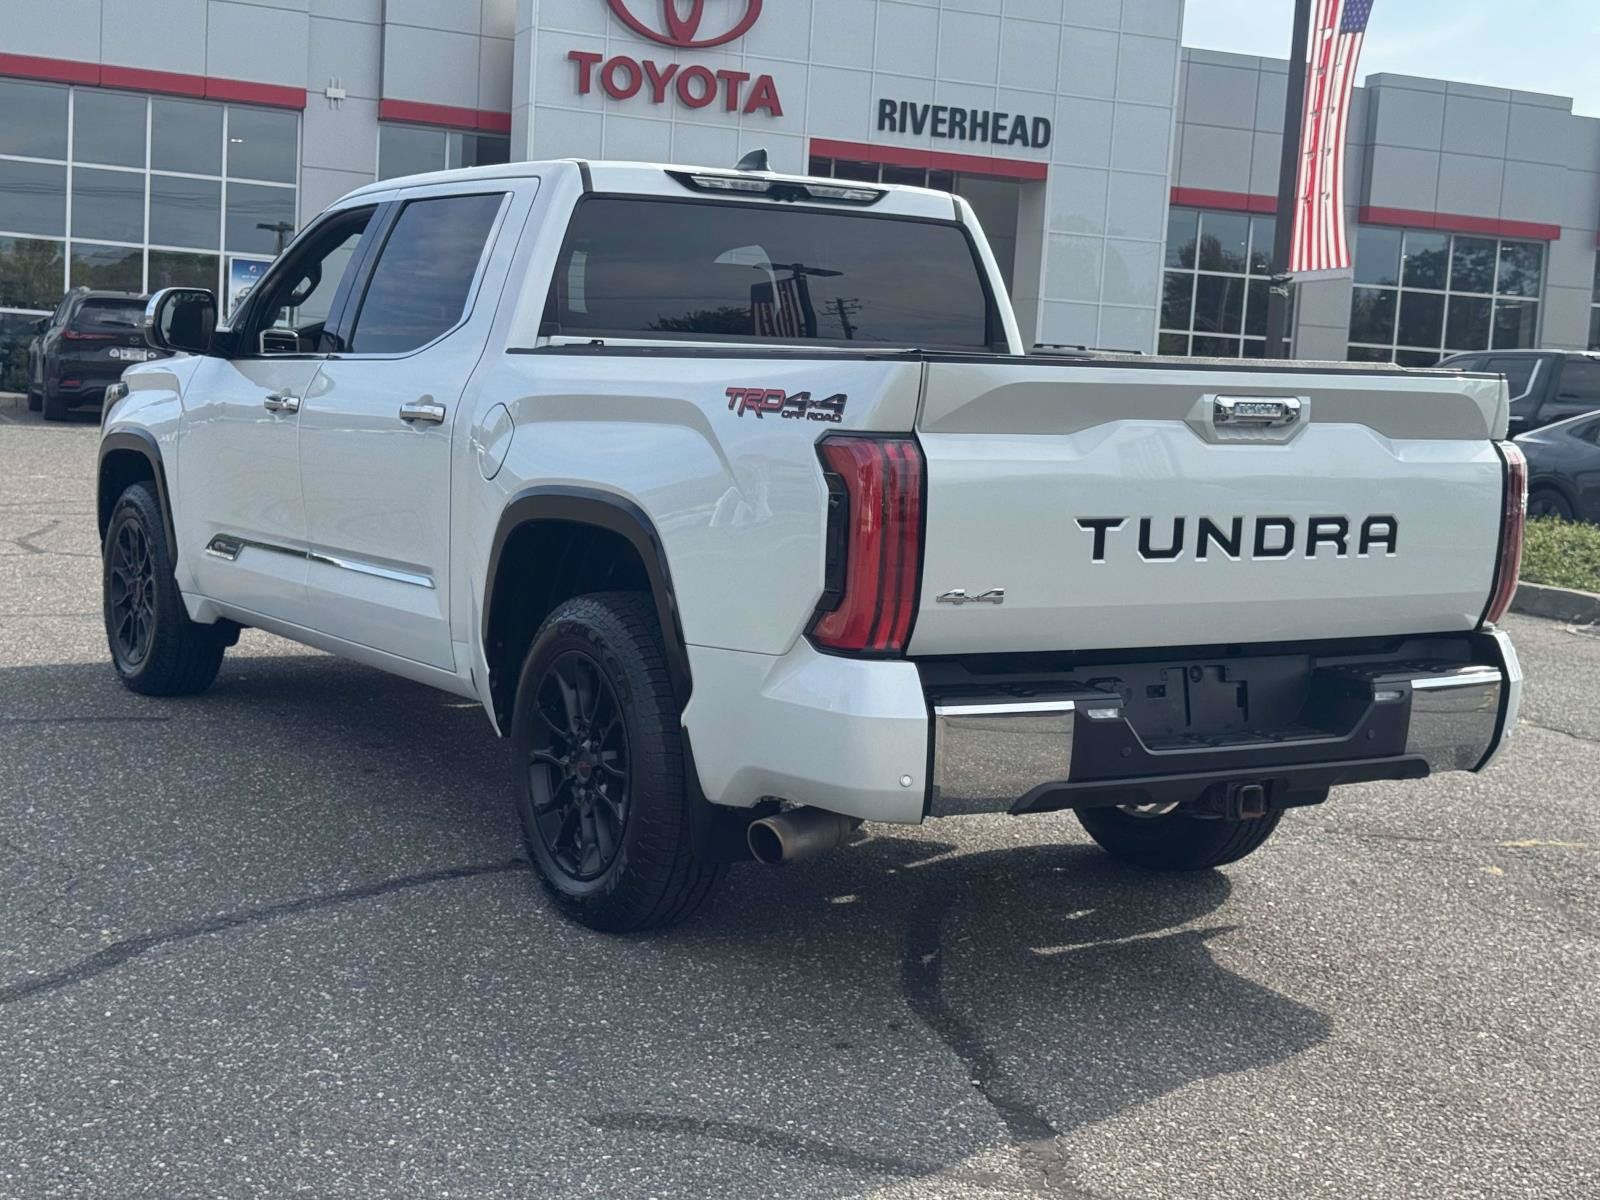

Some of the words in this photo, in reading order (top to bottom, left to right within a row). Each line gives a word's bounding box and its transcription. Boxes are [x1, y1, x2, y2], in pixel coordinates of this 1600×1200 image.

[567, 50, 784, 117] TOYOTA
[877, 98, 1052, 149] RIVERHEAD
[725, 387, 786, 419] TRD
[781, 410, 806, 420] OFF
[806, 411, 843, 424] ROAD
[1073, 514, 1399, 563] TUNDRA
